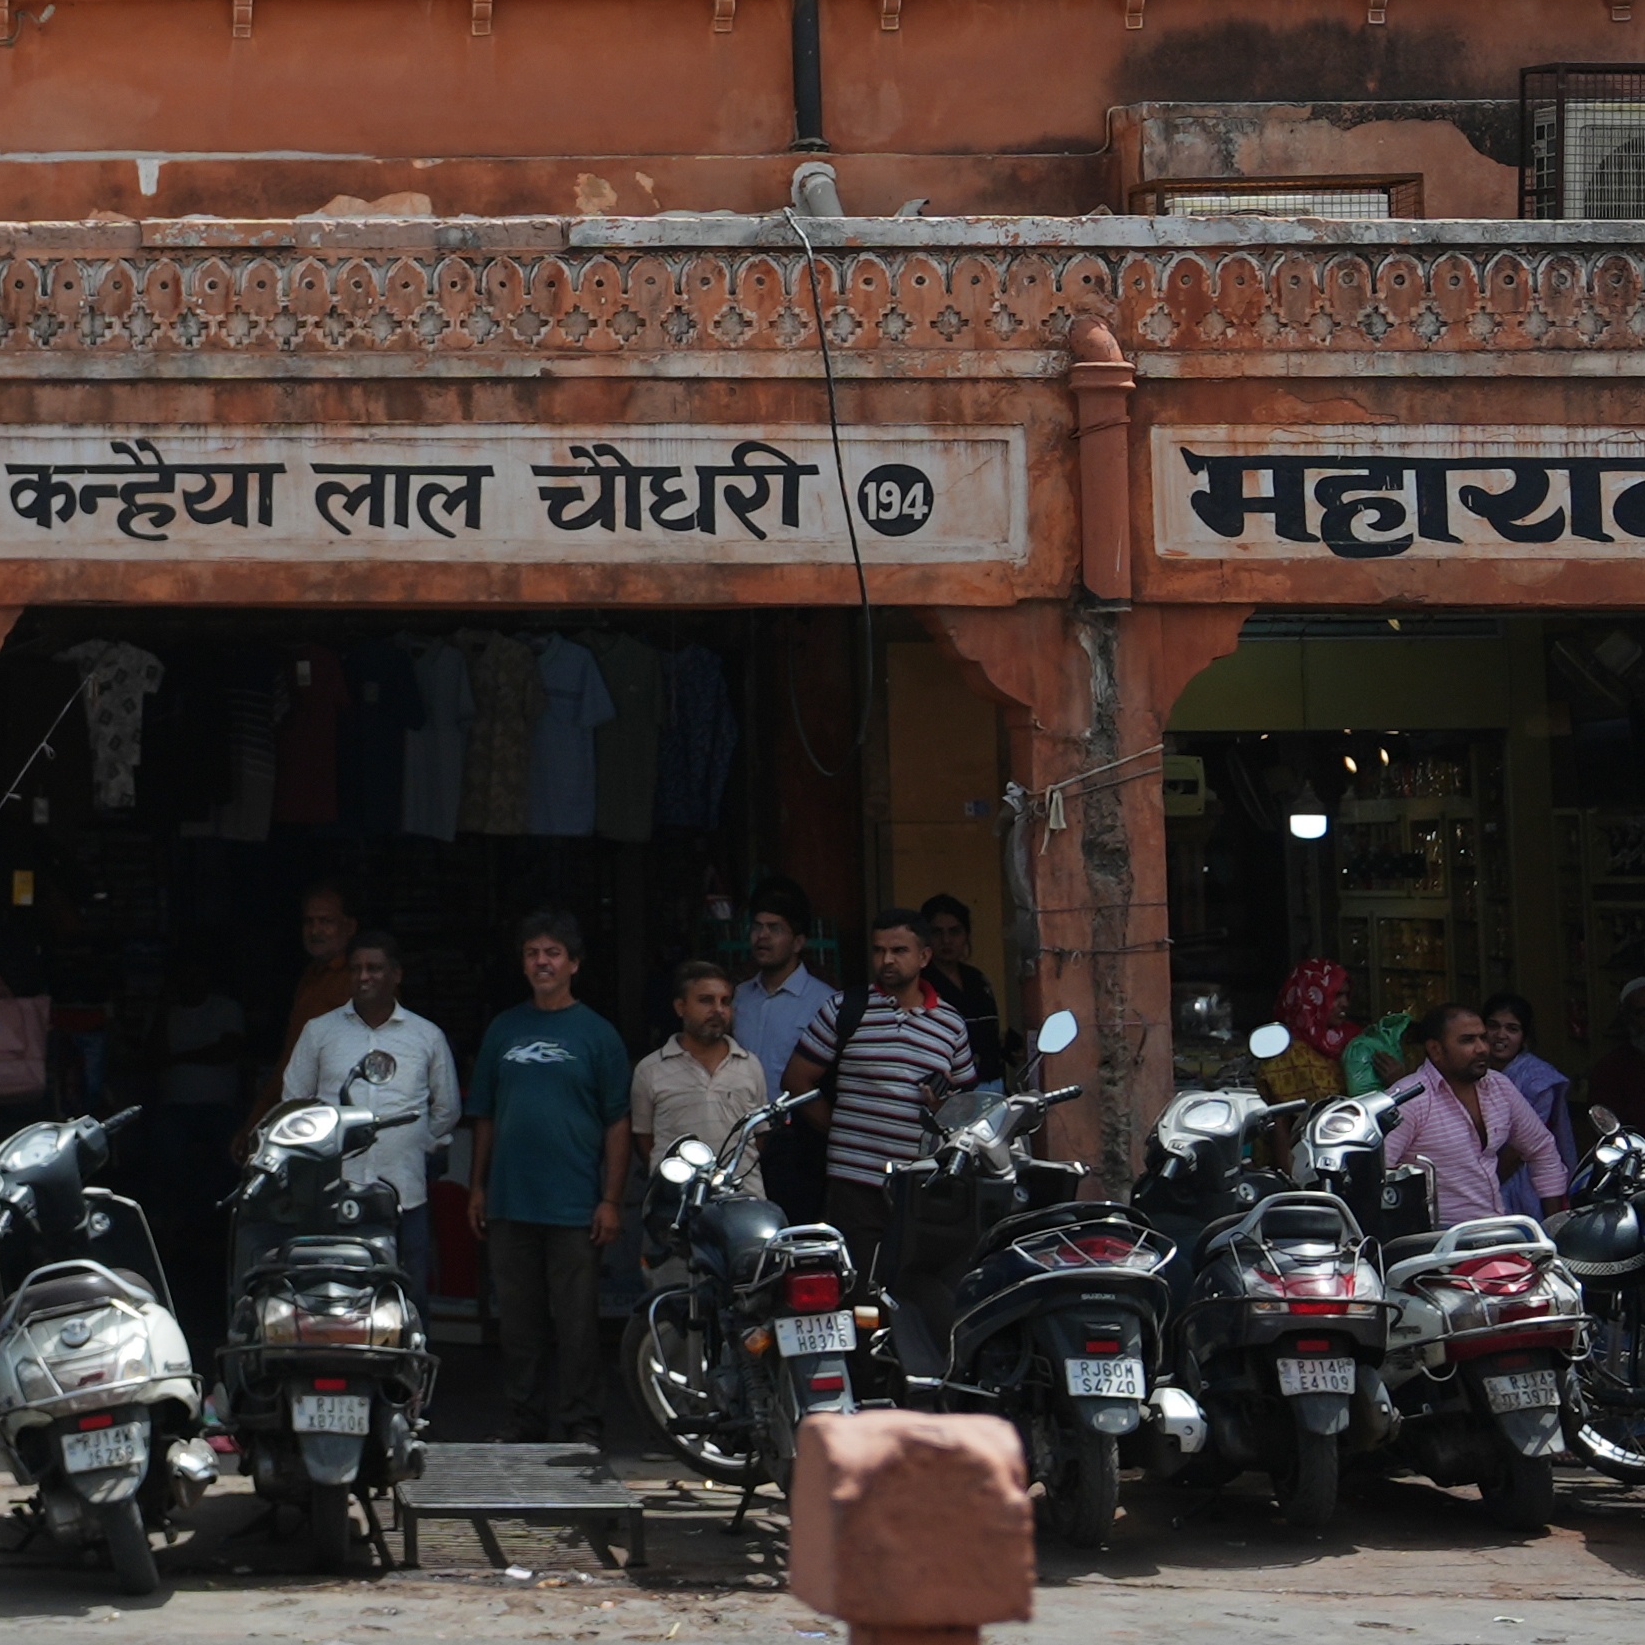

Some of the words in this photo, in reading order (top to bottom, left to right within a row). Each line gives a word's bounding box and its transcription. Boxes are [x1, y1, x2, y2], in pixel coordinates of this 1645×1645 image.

[5, 438, 287, 543] कन्हैया
[312, 462, 495, 539] लाल
[530, 440, 821, 542] चौधरी
[861, 479, 929, 523] 194
[794, 1315, 845, 1336] RJ14L
[798, 1333, 848, 1353] H8376
[1300, 1374, 1349, 1390] E4109
[1509, 1374, 1548, 1390] RJ14
